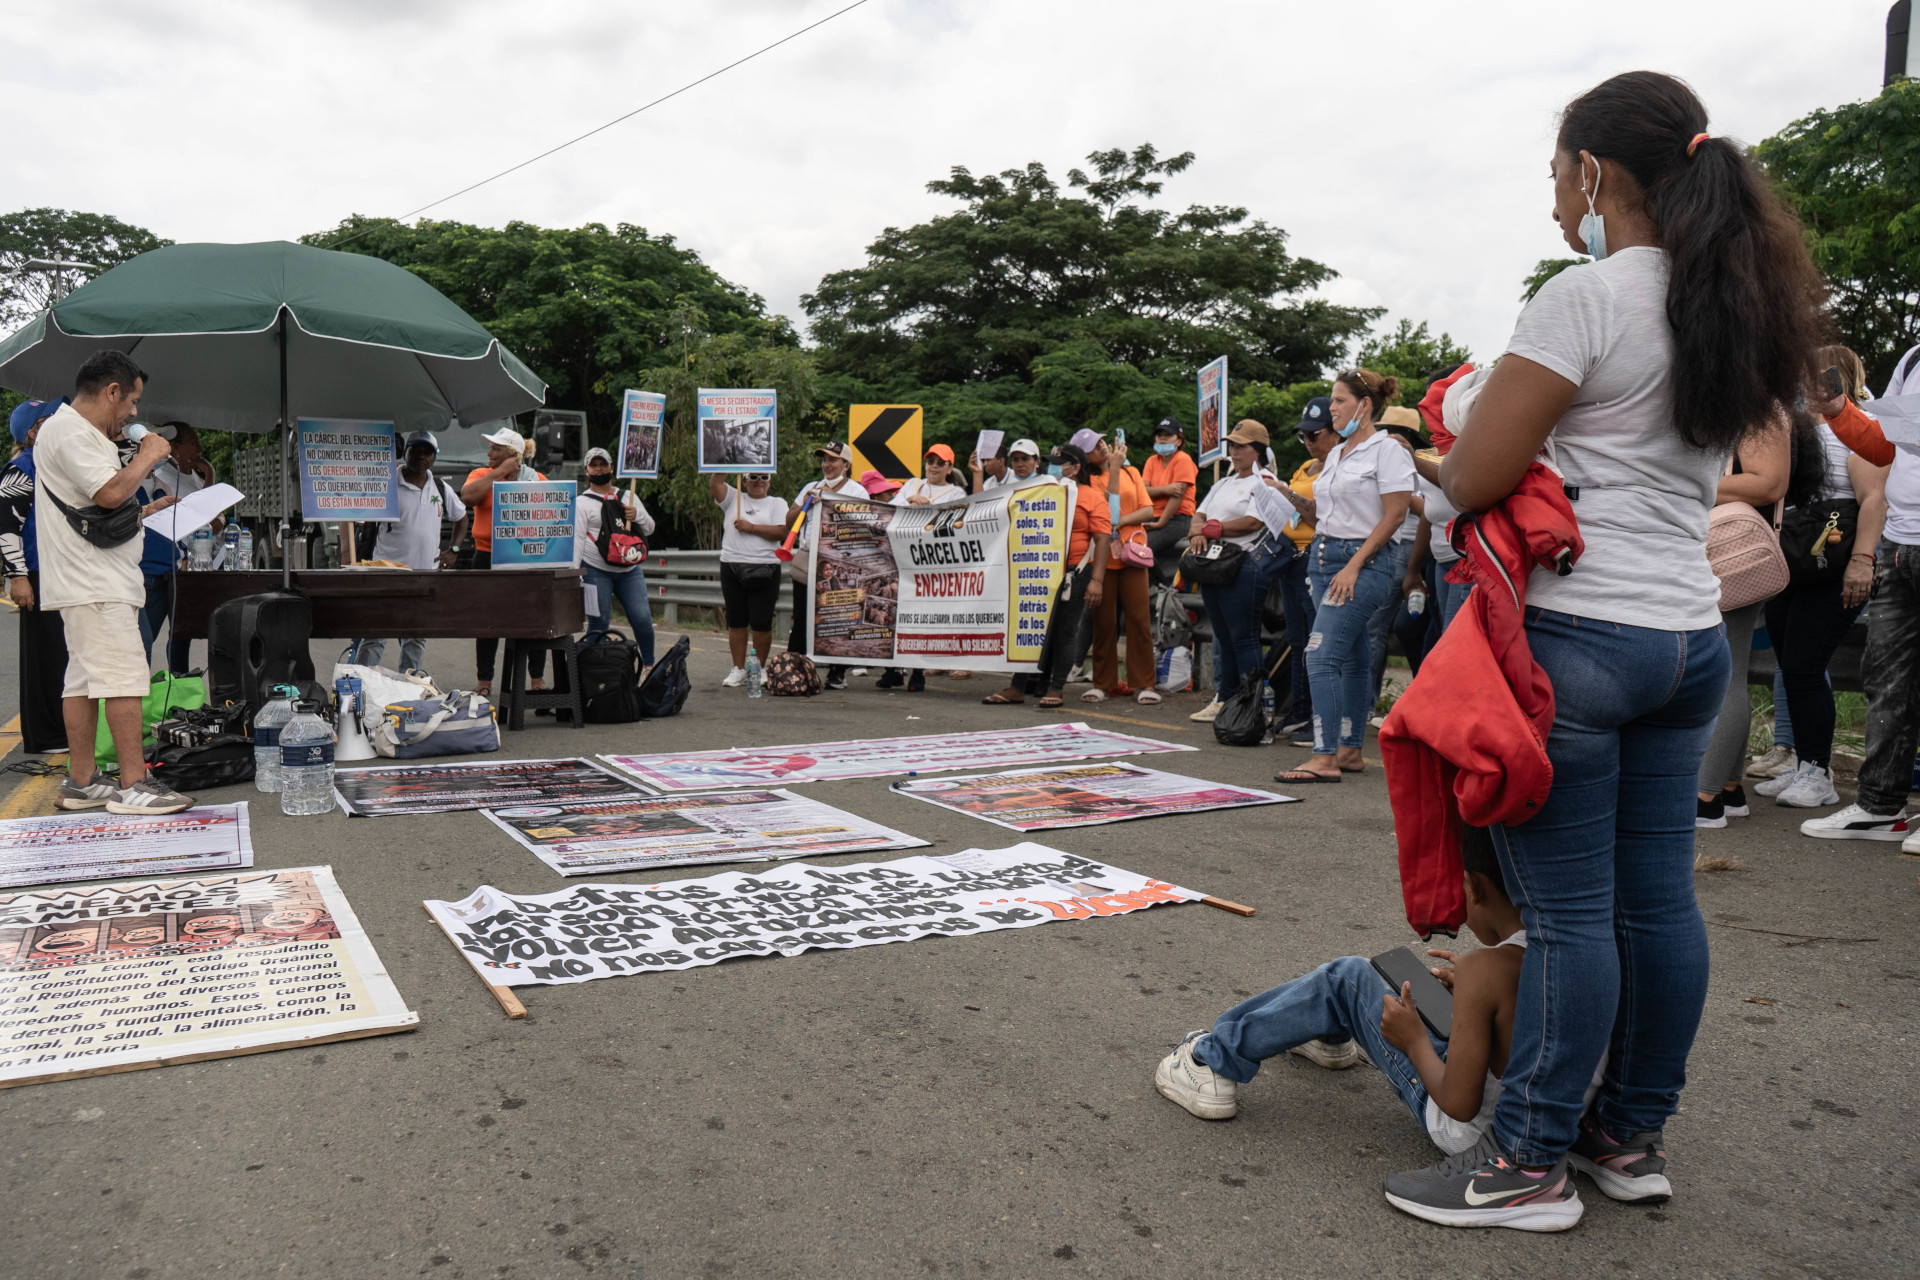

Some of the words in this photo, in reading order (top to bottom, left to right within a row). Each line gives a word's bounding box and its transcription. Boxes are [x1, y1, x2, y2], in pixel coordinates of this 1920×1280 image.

[701, 397, 705, 405] 6
[706, 397, 726, 405] MESES
[727, 397, 773, 405] SECUESTRADOS
[713, 407, 725, 415] POR
[727, 407, 734, 415] EL
[304, 432, 313, 444] LA
[314, 431, 339, 445] CÁRCEL
[340, 434, 352, 445] DEL
[353, 434, 391, 446] ENCUENTRO
[306, 449, 316, 460] NO
[317, 449, 342, 461] CONOCE
[344, 450, 351, 461] EL
[353, 450, 380, 461] RESPETO
[382, 451, 391, 462] DE
[309, 465, 321, 476] LOS
[322, 465, 356, 477] DERECHOS
[357, 466, 391, 479] HUMANOS,
[314, 481, 326, 492] LOS
[328, 481, 363, 493] QUEREMOS
[363, 481, 381, 493] VIVOS
[382, 482, 388, 492] Y
[318, 497, 331, 508] LOS
[332, 495, 352, 508] ESTÁN
[353, 497, 386, 508] MATANDO!
[500, 492, 508, 503] NO
[509, 492, 529, 503] TIENEN
[530, 492, 544, 503] AGUA
[545, 491, 571, 505] POTABLE,
[1031, 498, 1056, 512] están
[834, 502, 872, 513] CÁRCEL
[502, 510, 509, 521] NO
[511, 509, 530, 521] TIENEN
[531, 509, 559, 522] MEDICINA,
[560, 509, 568, 520] NO
[1016, 516, 1040, 530] solos,
[1042, 517, 1054, 528] su
[496, 527, 515, 538] TIENEN
[516, 526, 537, 538] COMIDA
[538, 526, 545, 537] EL
[546, 525, 573, 537] GOBIERNO
[1021, 531, 1050, 546] familia
[522, 543, 546, 554] MIENTE!
[909, 538, 960, 566] CÁRCEL
[959, 539, 986, 563] DEL
[1012, 548, 1039, 563] camina
[1042, 551, 1059, 562] con
[1018, 565, 1050, 579] ustedes
[913, 570, 985, 597] ENCUENTRO
[1018, 582, 1049, 596] incluso
[1019, 599, 1047, 613] detrás
[899, 613, 912, 624] VIVOS
[913, 613, 919, 624] SE
[920, 613, 929, 624] LOS
[952, 613, 965, 624] VIVOS
[966, 613, 974, 624] LOS
[975, 613, 1004, 626] QUEREMOS
[1019, 616, 1028, 629] de
[1030, 616, 1045, 630] los
[962, 639, 971, 651] NO
[971, 639, 1001, 652] SILENCIO!
[1016, 632, 1046, 646] MUROS
[733, 877, 802, 894] de
[870, 879, 933, 893] de
[64, 968, 87, 977] en
[101, 959, 174, 973] Ecuador
[187, 953, 223, 963] está
[236, 942, 330, 958] respaldado
[598, 949, 694, 972] nos
[30, 972, 149, 991] Constitución,
[161, 967, 178, 977] el
[188, 960, 249, 974] Código
[259, 951, 334, 967] Orgánico
[14, 993, 34, 1003] el
[36, 981, 151, 1002] Reglamento
[156, 977, 186, 988] del
[190, 970, 260, 984] Sistema
[264, 960, 339, 976] Nacional
[0, 1004, 39, 1017] cial,
[54, 994, 132, 1010] además
[143, 990, 167, 1000] de
[179, 980, 257, 996] diversos
[268, 970, 343, 986] tratados
[100, 999, 194, 1018] humanos.
[210, 990, 260, 1004] Estos
[275, 980, 347, 997] cuerpos
[11, 1019, 108, 1041] derechos
[116, 1003, 268, 1027] fundamentales,
[277, 994, 327, 1008] como
[335, 991, 351, 1001] la
[0, 1038, 63, 1055] sonal,
[74, 1035, 94, 1046] la
[102, 1026, 164, 1043] salud,
[173, 1023, 192, 1034] la
[200, 1005, 331, 1030] alimentación,
[339, 1002, 357, 1013] la
[36, 1053, 58, 1063] la
